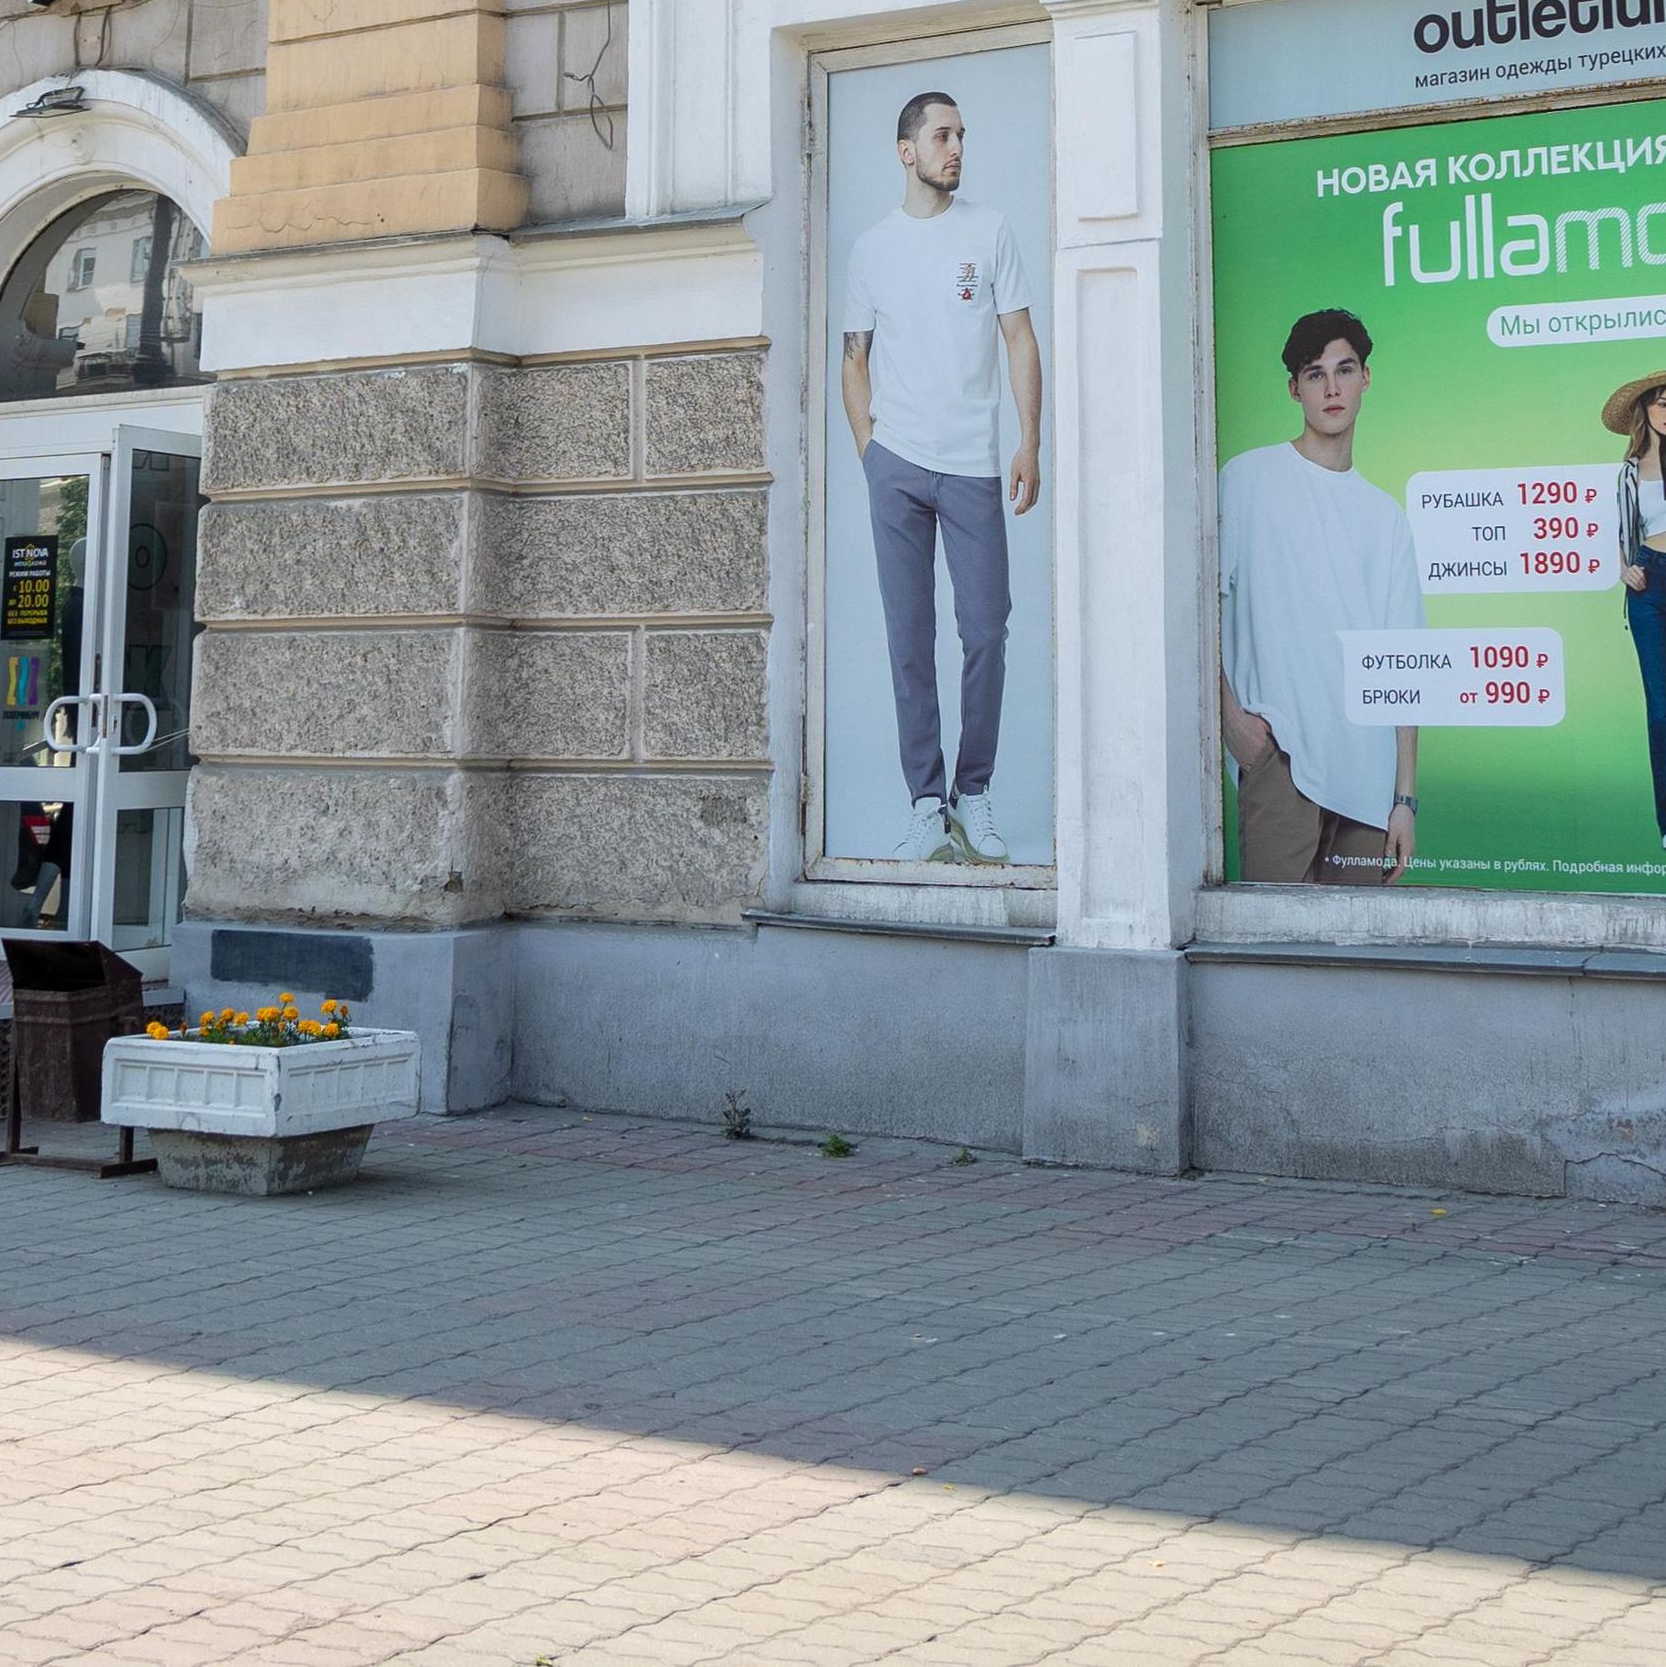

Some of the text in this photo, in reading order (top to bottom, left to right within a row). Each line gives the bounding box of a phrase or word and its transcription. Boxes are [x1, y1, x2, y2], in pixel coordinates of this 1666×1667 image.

[1415, 68, 1490, 89] магазин
[1495, 55, 1572, 79] одежды
[1578, 44, 1666, 72] турецких
[1316, 157, 1437, 198] НОВАЯ
[1499, 311, 1540, 337] Мы
[1422, 492, 1504, 509] РУБАШКА
[1517, 481, 1577, 505] 1290
[1472, 525, 1506, 541] ТОП
[1533, 517, 1579, 540] 390
[1428, 561, 1507, 580] ДЖИНСЫ
[1520, 551, 1581, 575] 1890
[19, 579, 50, 594] 10.00
[18, 594, 49, 608] 20.00
[1362, 654, 1452, 670] ФУТБОЛКА
[1470, 645, 1529, 668] 1090
[1362, 689, 1420, 704] БРЮКИ
[1460, 692, 1478, 703] от
[1485, 681, 1530, 704] 990
[1403, 856, 1436, 869] Цены
[1439, 857, 1491, 872] указаны
[1494, 860, 1501, 869] в
[1504, 858, 1549, 873] рублях.
[1553, 860, 1622, 875] Подробная
